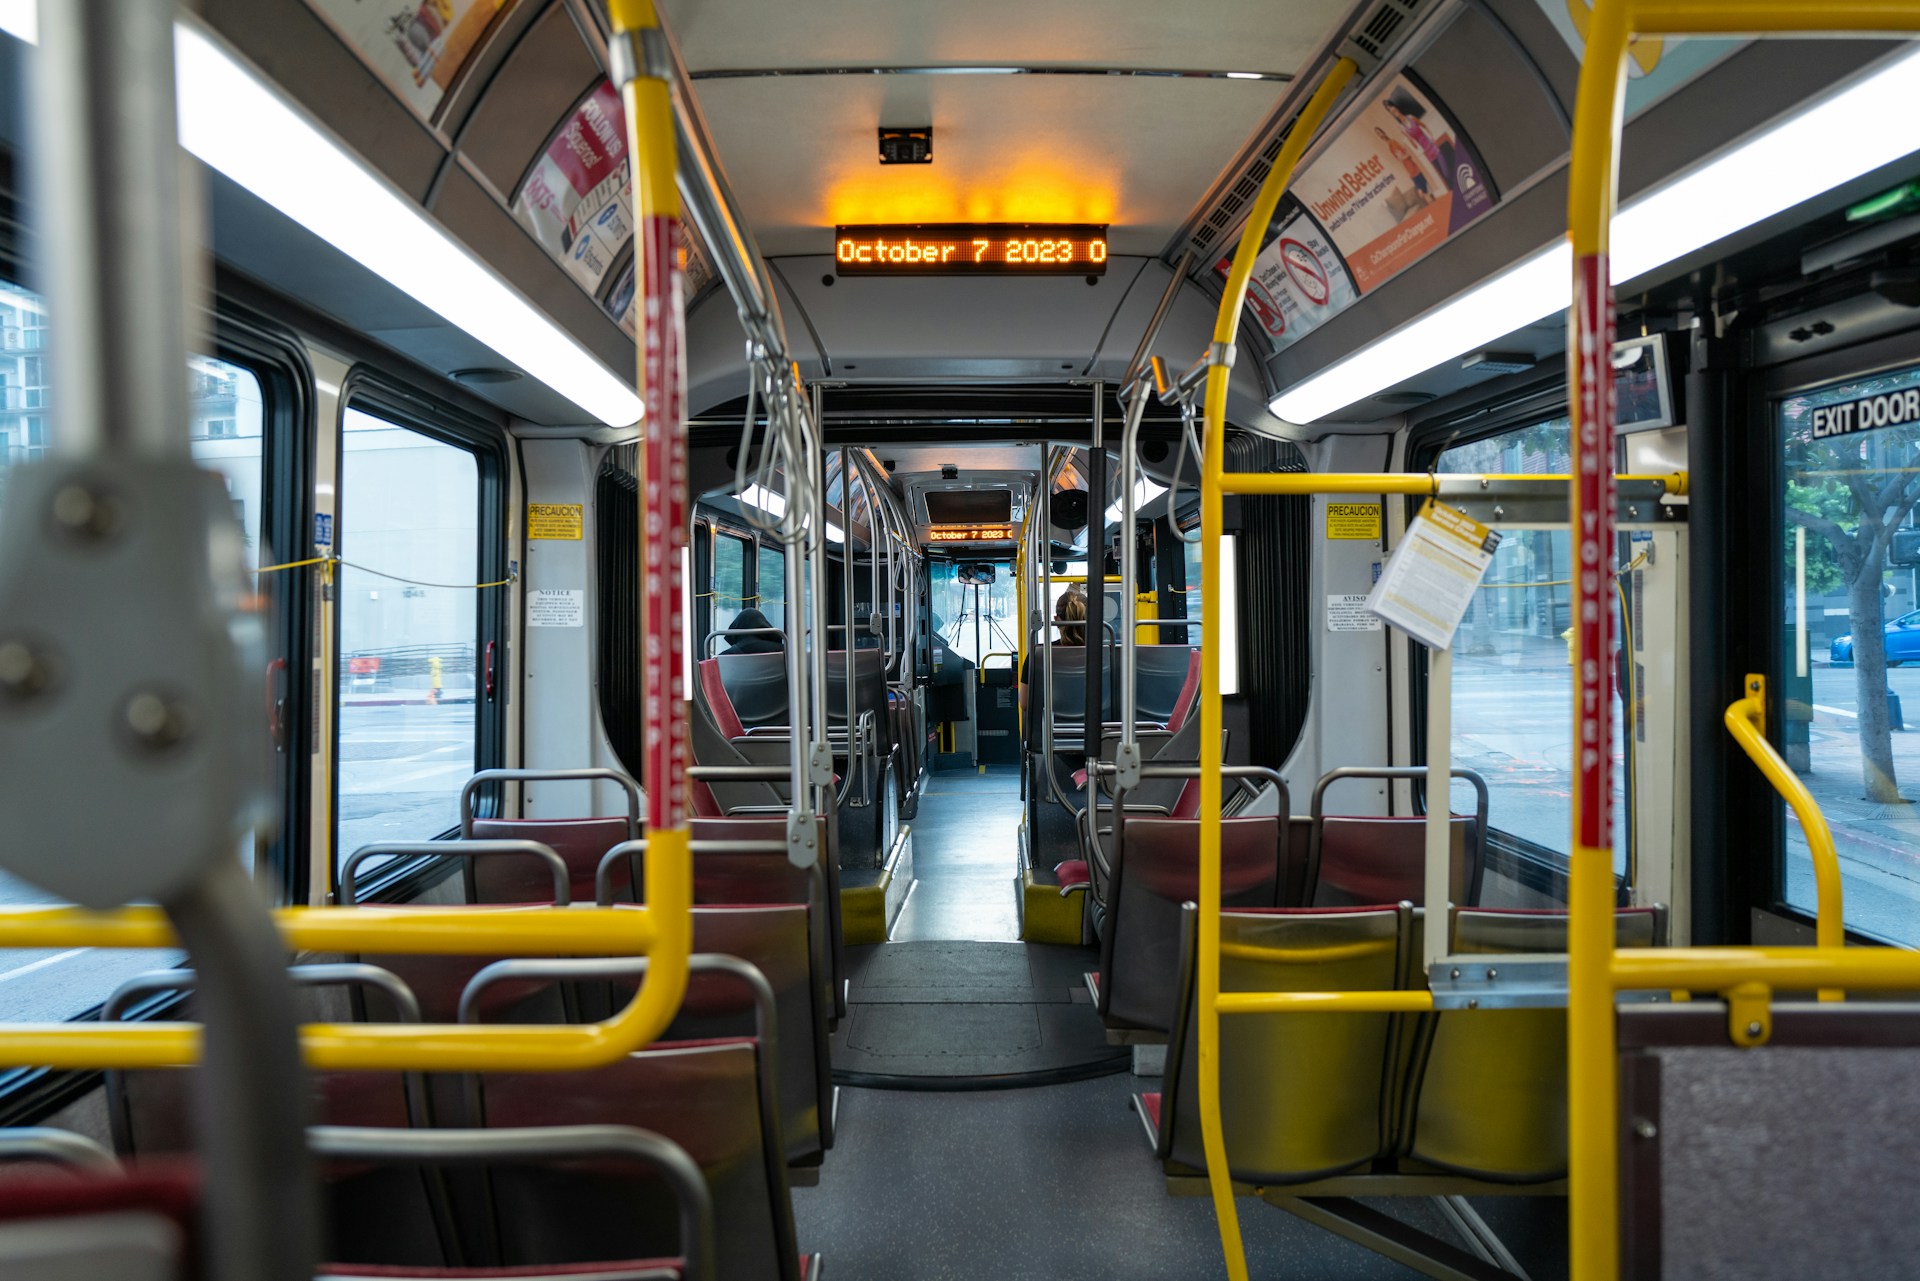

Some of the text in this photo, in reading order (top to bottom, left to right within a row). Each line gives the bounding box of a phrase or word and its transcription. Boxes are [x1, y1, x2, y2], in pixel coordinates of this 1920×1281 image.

[579, 98, 617, 145] FOLLOW
[1310, 178, 1354, 221] Unwind
[1342, 153, 1384, 193] Better
[838, 240, 955, 262] October
[972, 240, 989, 262] 7
[1006, 240, 1073, 262] 2023
[1813, 389, 1920, 438] EXIT DOOR
[530, 507, 581, 516] PRECAUCION
[1329, 506, 1378, 515] PRECAUCION
[646, 481, 662, 596] YOUR
[930, 531, 967, 540] October
[972, 531, 978, 539] 7
[982, 530, 1003, 539] 2023
[1581, 332, 1599, 772] WATCH YOUR STEP
[646, 634, 662, 747] STEP
